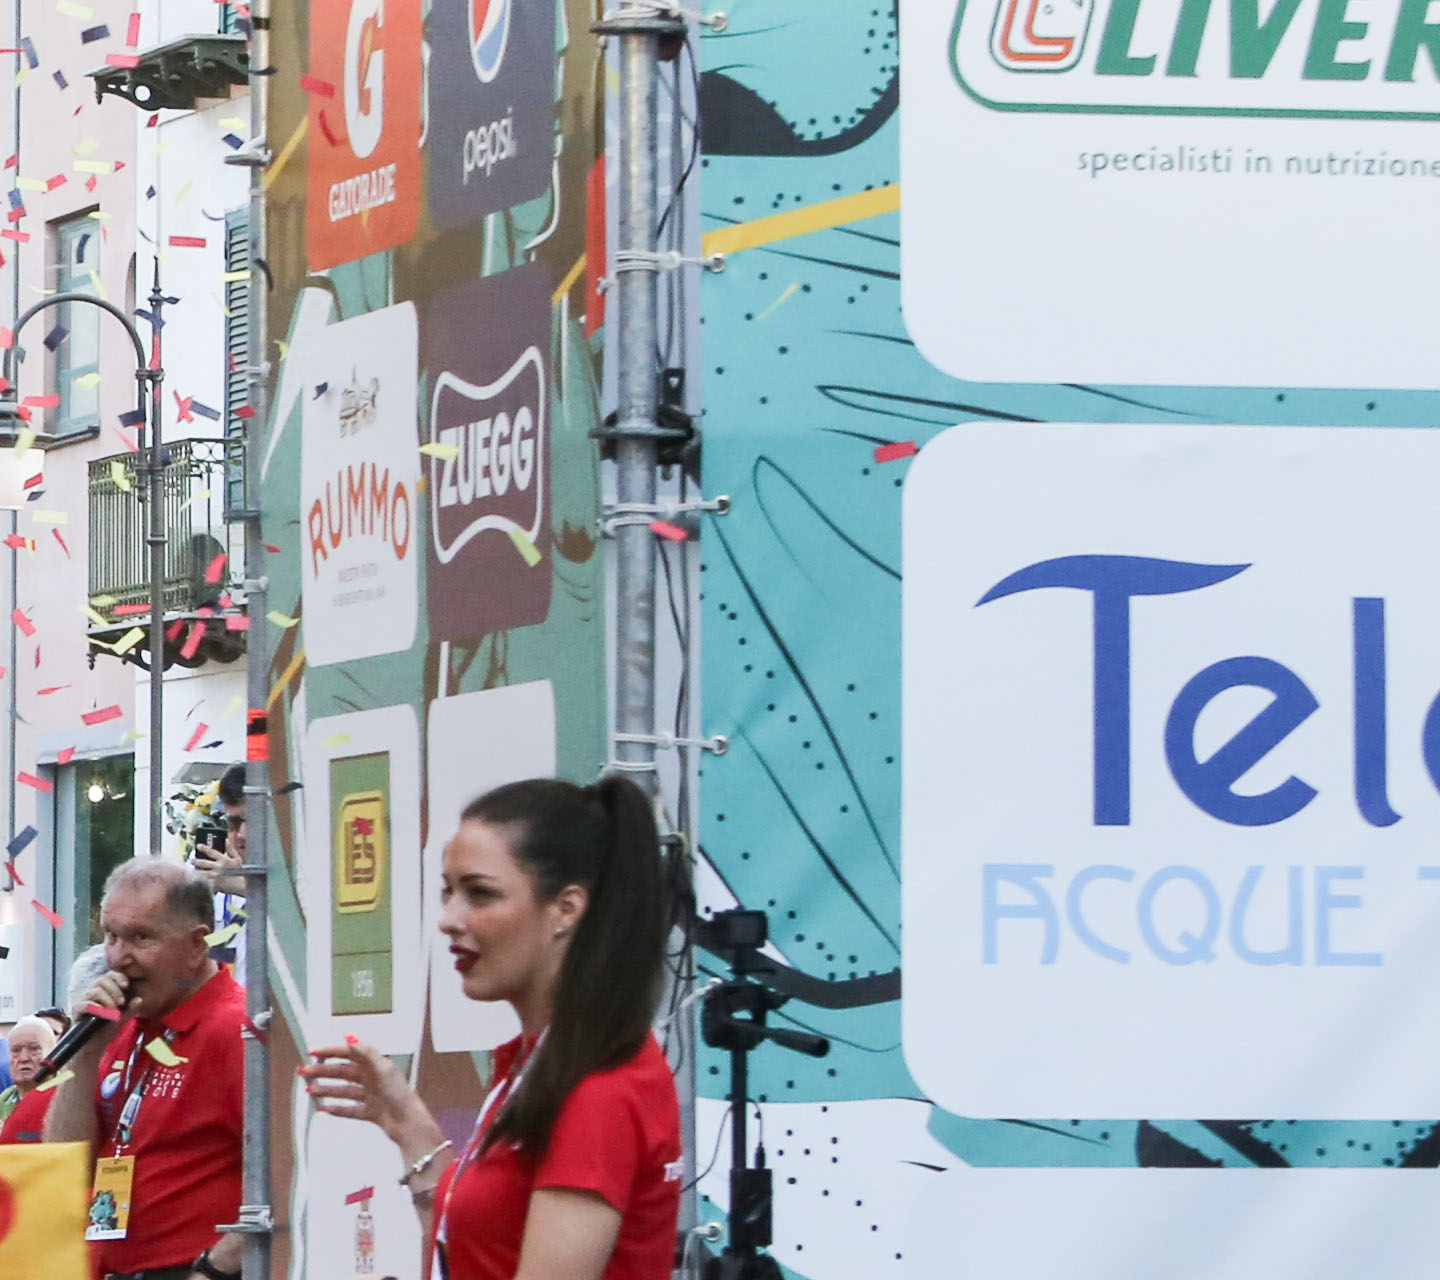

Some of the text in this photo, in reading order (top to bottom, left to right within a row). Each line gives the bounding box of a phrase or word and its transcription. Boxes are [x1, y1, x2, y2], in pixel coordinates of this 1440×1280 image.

[328, 162, 398, 223] GATORADE
[462, 104, 514, 186] pepsi
[1077, 146, 1232, 178] specialisti
[1245, 148, 1272, 173] in
[439, 405, 535, 508] ZUEGG
[309, 460, 410, 580] RUMMO
[973, 553, 1440, 829] Tel
[980, 863, 1384, 967] ACQUE
